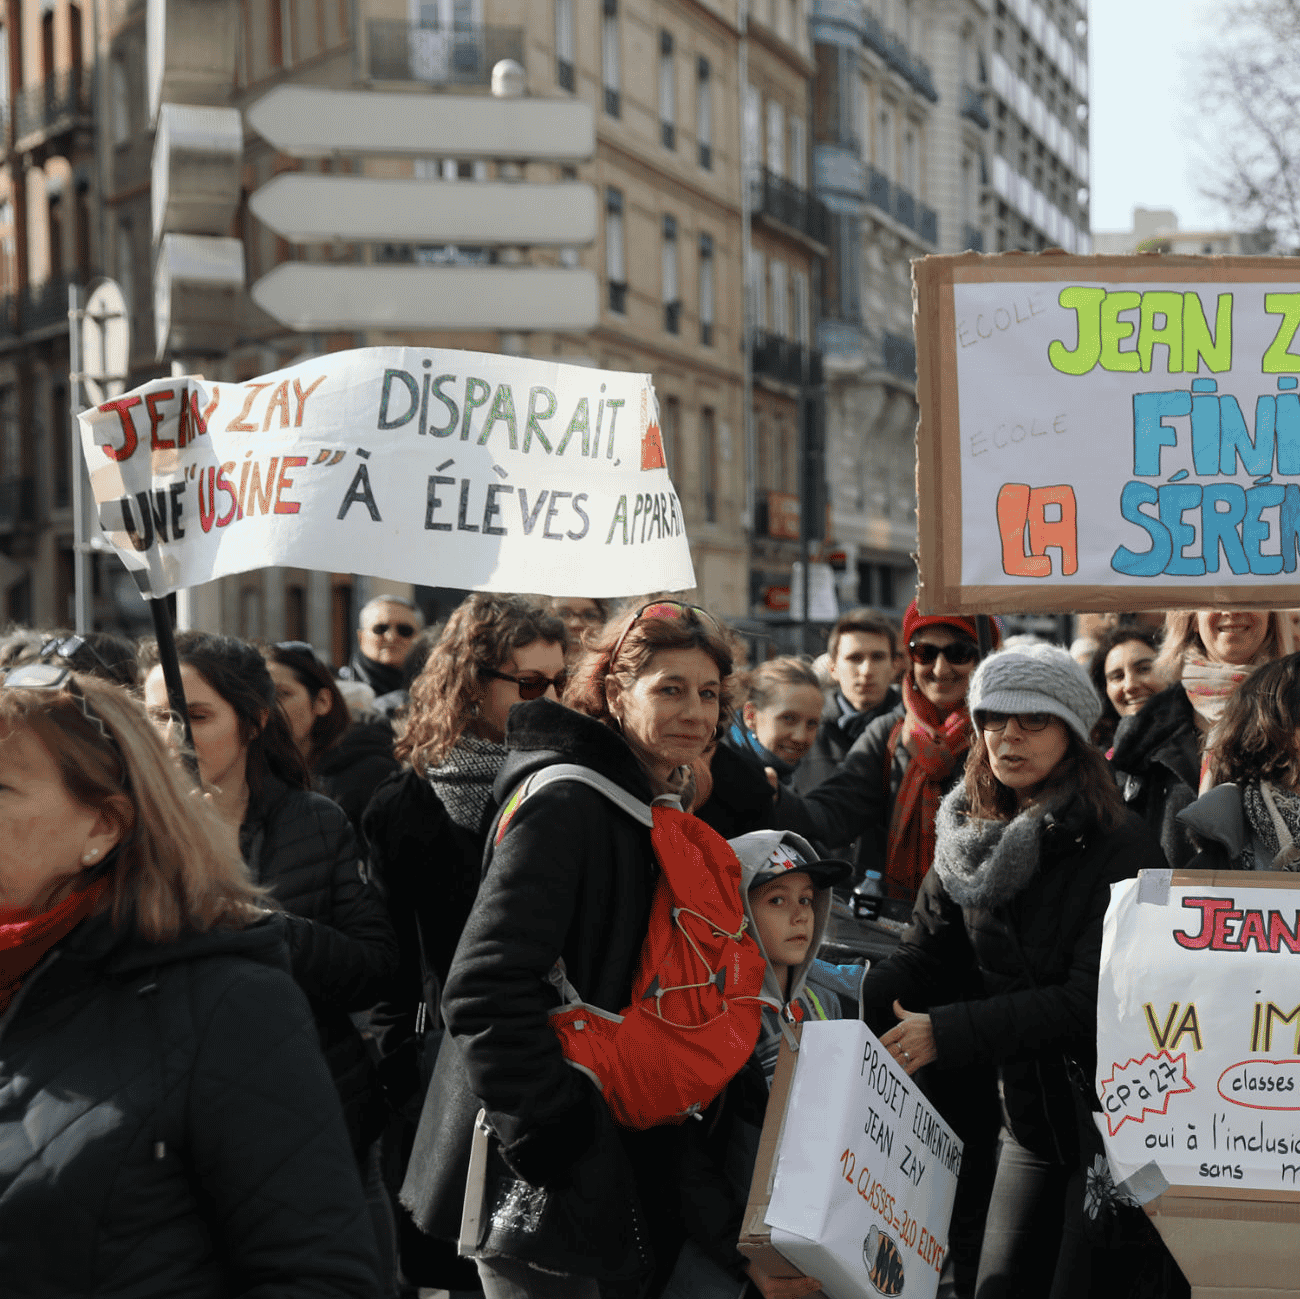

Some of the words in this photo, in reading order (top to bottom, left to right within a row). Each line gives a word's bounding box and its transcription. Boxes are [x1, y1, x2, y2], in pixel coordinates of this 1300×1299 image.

[1047, 286, 1234, 376] JEAN
[99, 386, 220, 463] JEAN
[225, 375, 328, 432] ZAY
[120, 481, 187, 552] UNE
[337, 447, 383, 522] À
[424, 458, 590, 541] ÉLÈVES
[996, 483, 1078, 577] LA
[1142, 1001, 1203, 1051] VA
[861, 1040, 909, 1119] PROJET
[1106, 1084, 1131, 1113] CP
[1131, 1079, 1152, 1100] à
[1149, 1061, 1177, 1093] 27
[1232, 1068, 1295, 1093] classes
[864, 1106, 894, 1159] JEAN
[900, 1144, 926, 1187] ZAY
[1145, 1128, 1175, 1149] oui
[1187, 1123, 1198, 1150] à
[1199, 1160, 1244, 1180] sans
[840, 1148, 854, 1185] 12
[917, 1226, 946, 1274] ELEVE
